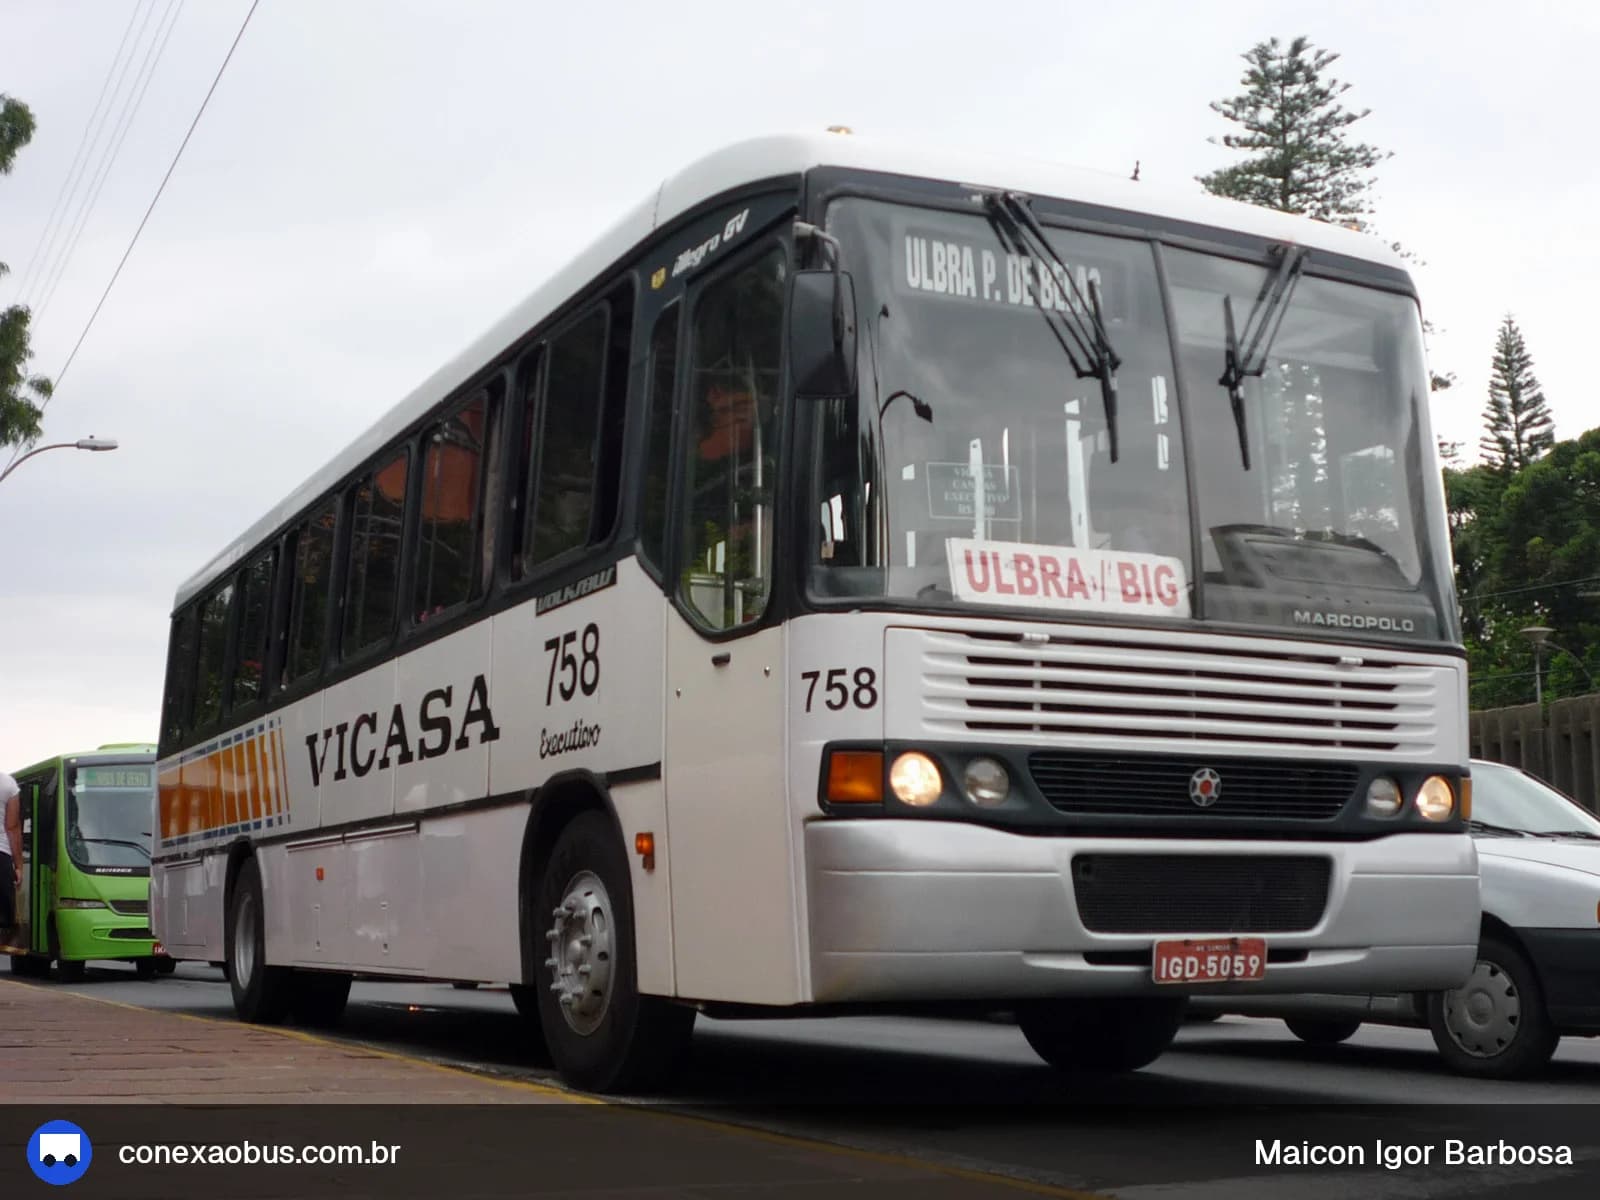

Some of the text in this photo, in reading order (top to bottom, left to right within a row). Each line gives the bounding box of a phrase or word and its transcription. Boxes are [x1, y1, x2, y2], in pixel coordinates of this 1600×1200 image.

[722, 207, 750, 242] GV
[904, 235, 977, 298] ULBRA
[981, 249, 1001, 301] P.
[1006, 253, 1035, 306] DE
[964, 549, 1090, 600] ULBRA
[1116, 561, 1179, 607] BIG
[1293, 609, 1415, 633] MARCOPOLO
[544, 622, 600, 706] 758
[801, 666, 878, 713] 758
[305, 673, 500, 788] VICASA
